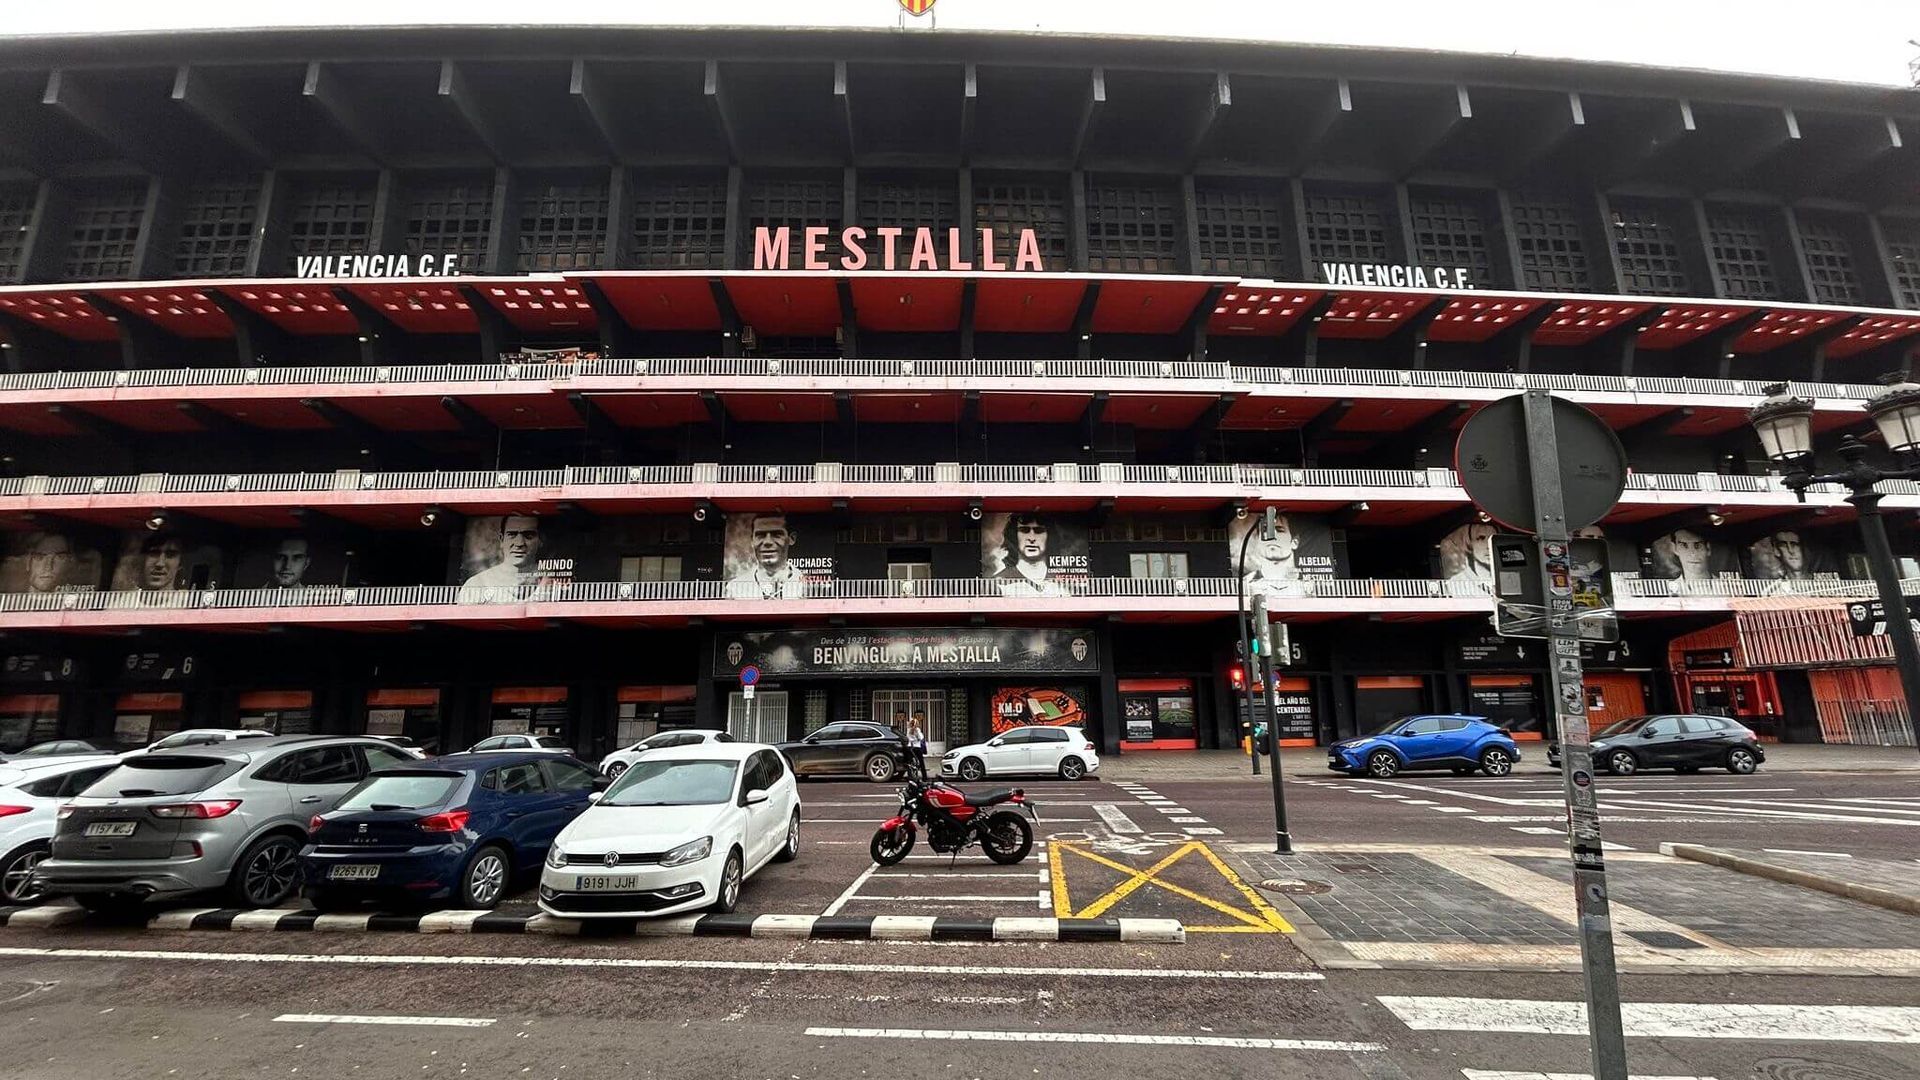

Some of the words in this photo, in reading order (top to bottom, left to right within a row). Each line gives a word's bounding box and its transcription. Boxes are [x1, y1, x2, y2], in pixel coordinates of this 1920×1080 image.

[754, 226, 1043, 271] MESTALLA
[297, 254, 409, 278] VALENCIA
[418, 254, 460, 277] C.F.
[1323, 263, 1428, 288] VALENCIA
[1434, 267, 1474, 290] C.F.
[538, 559, 573, 571] MUNDO
[1049, 555, 1088, 567] KEMPES
[1299, 556, 1332, 566] ALBELDA
[847, 636, 867, 645] 1923
[1620, 640, 1630, 656] 3
[814, 646, 908, 665] BENVINGUTS
[912, 647, 923, 664] A
[927, 646, 1000, 664] MESTALLA
[1292, 643, 1301, 660] 5
[62, 659, 72, 676] 8
[183, 656, 193, 674] 6
[1287, 696, 1299, 704] AÑO
[583, 878, 609, 889] 9191
[614, 877, 636, 888] JJH
